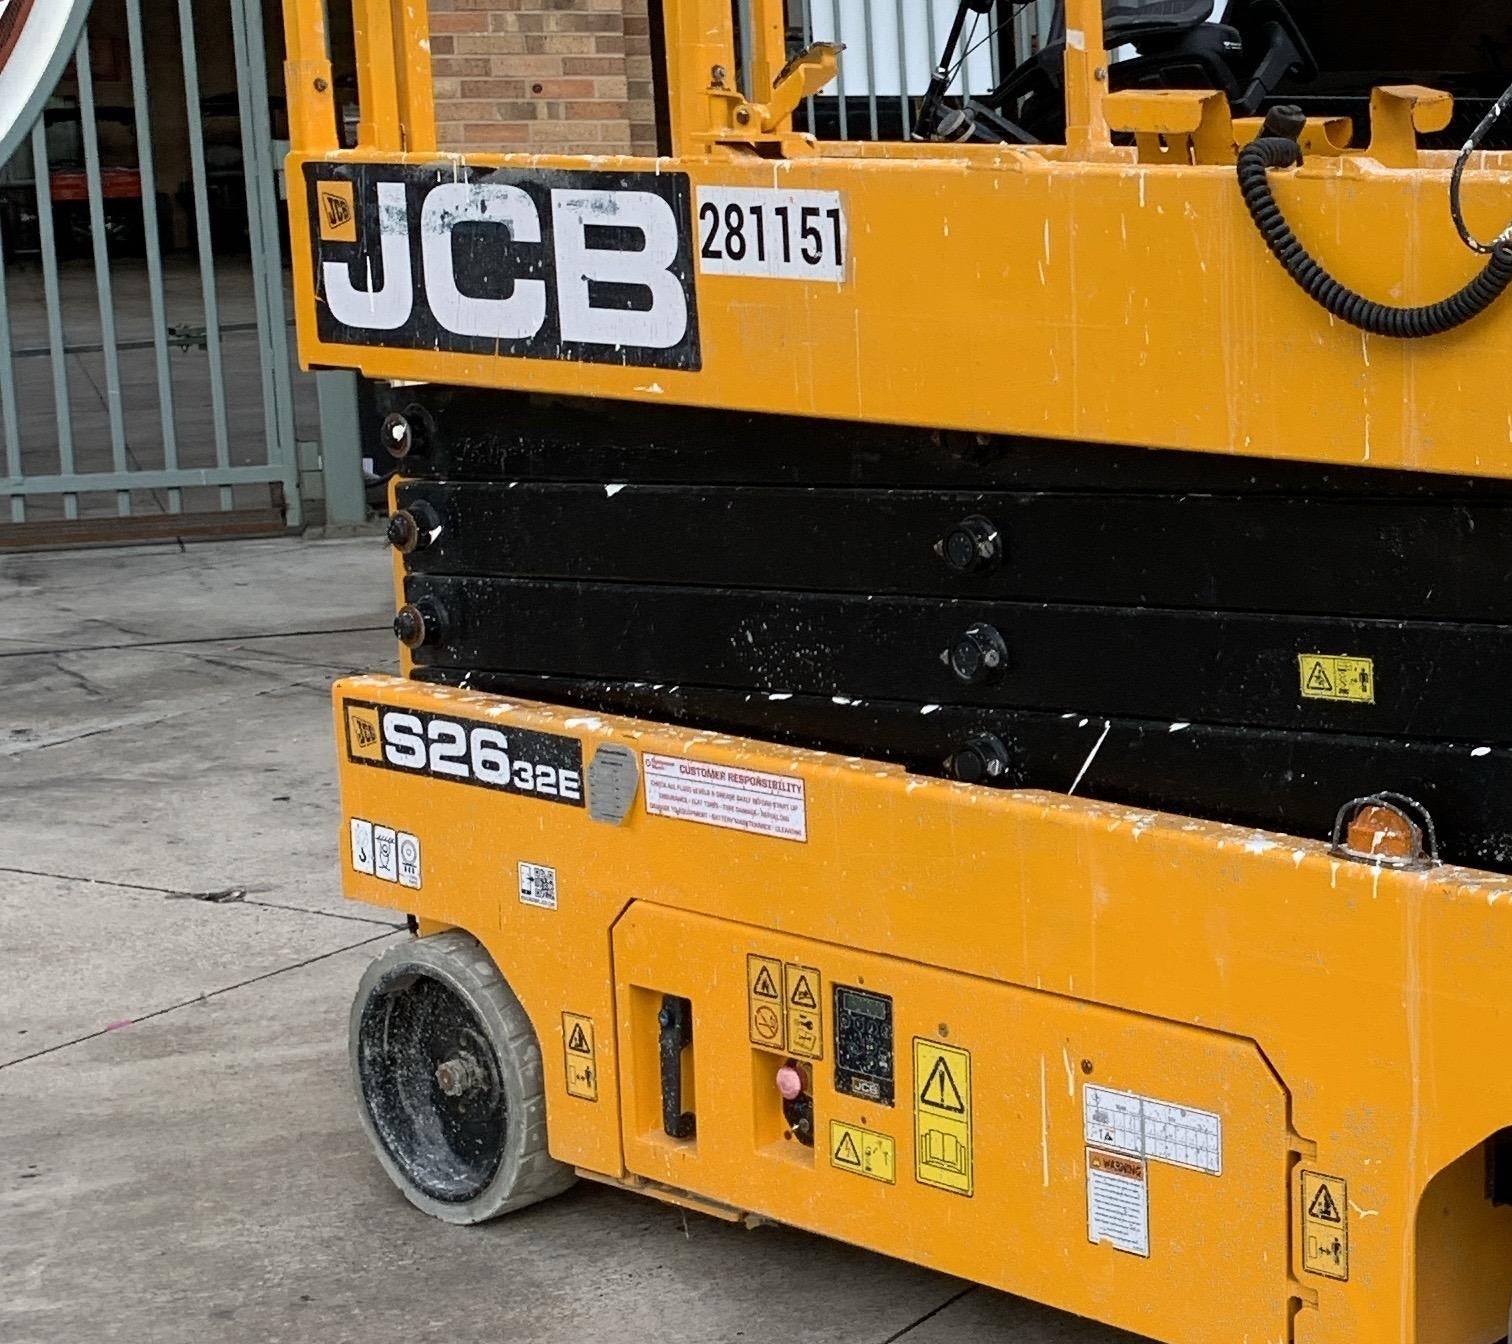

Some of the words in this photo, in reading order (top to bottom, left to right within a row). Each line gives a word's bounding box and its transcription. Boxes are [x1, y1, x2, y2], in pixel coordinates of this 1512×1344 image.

[322, 181, 688, 349] JCB
[699, 202, 843, 267] 281151
[679, 764, 726, 780] CUSTOMER
[727, 772, 802, 795] RESPONSIBILITY
